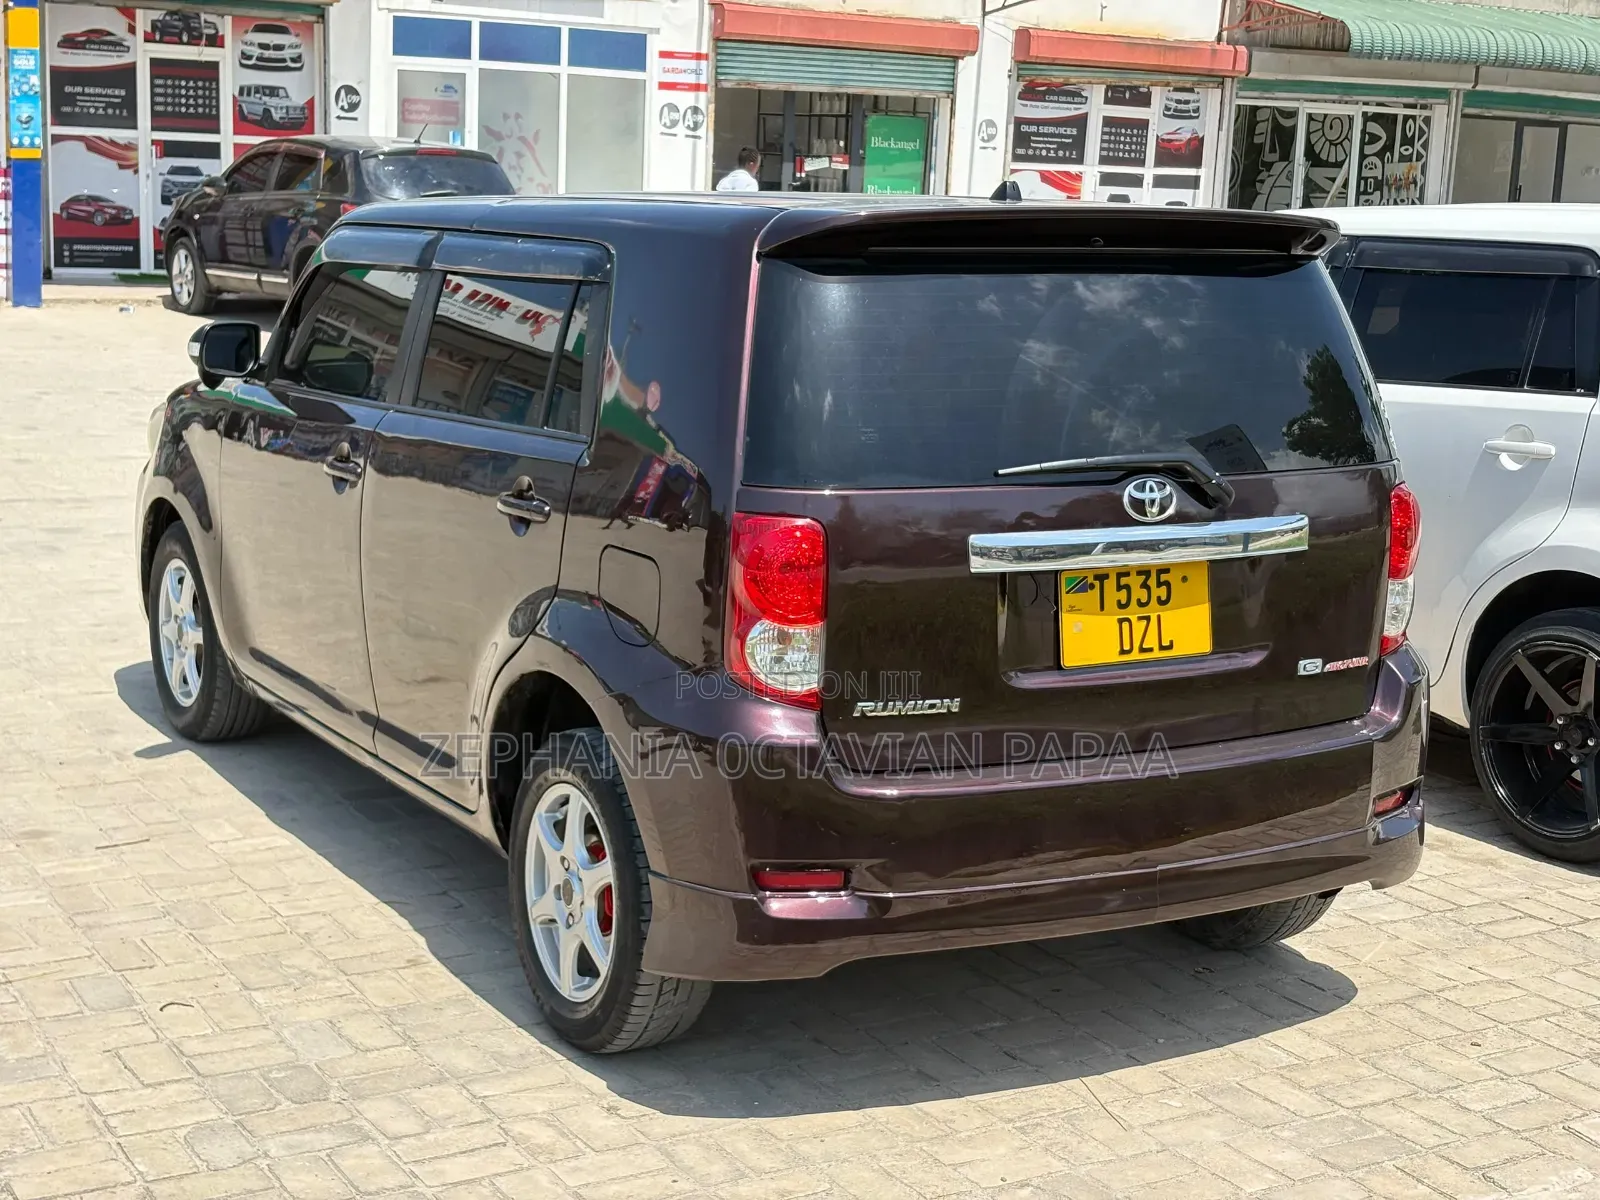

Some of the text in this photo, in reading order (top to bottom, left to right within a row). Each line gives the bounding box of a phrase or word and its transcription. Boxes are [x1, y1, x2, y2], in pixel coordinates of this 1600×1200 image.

[64, 85, 126, 96] OUR SERVICES
[1020, 125, 1078, 135] OUR SERVICES
[871, 136, 920, 151] Blackangel
[1117, 614, 1174, 656] DZL
[852, 698, 961, 717] RUMION
